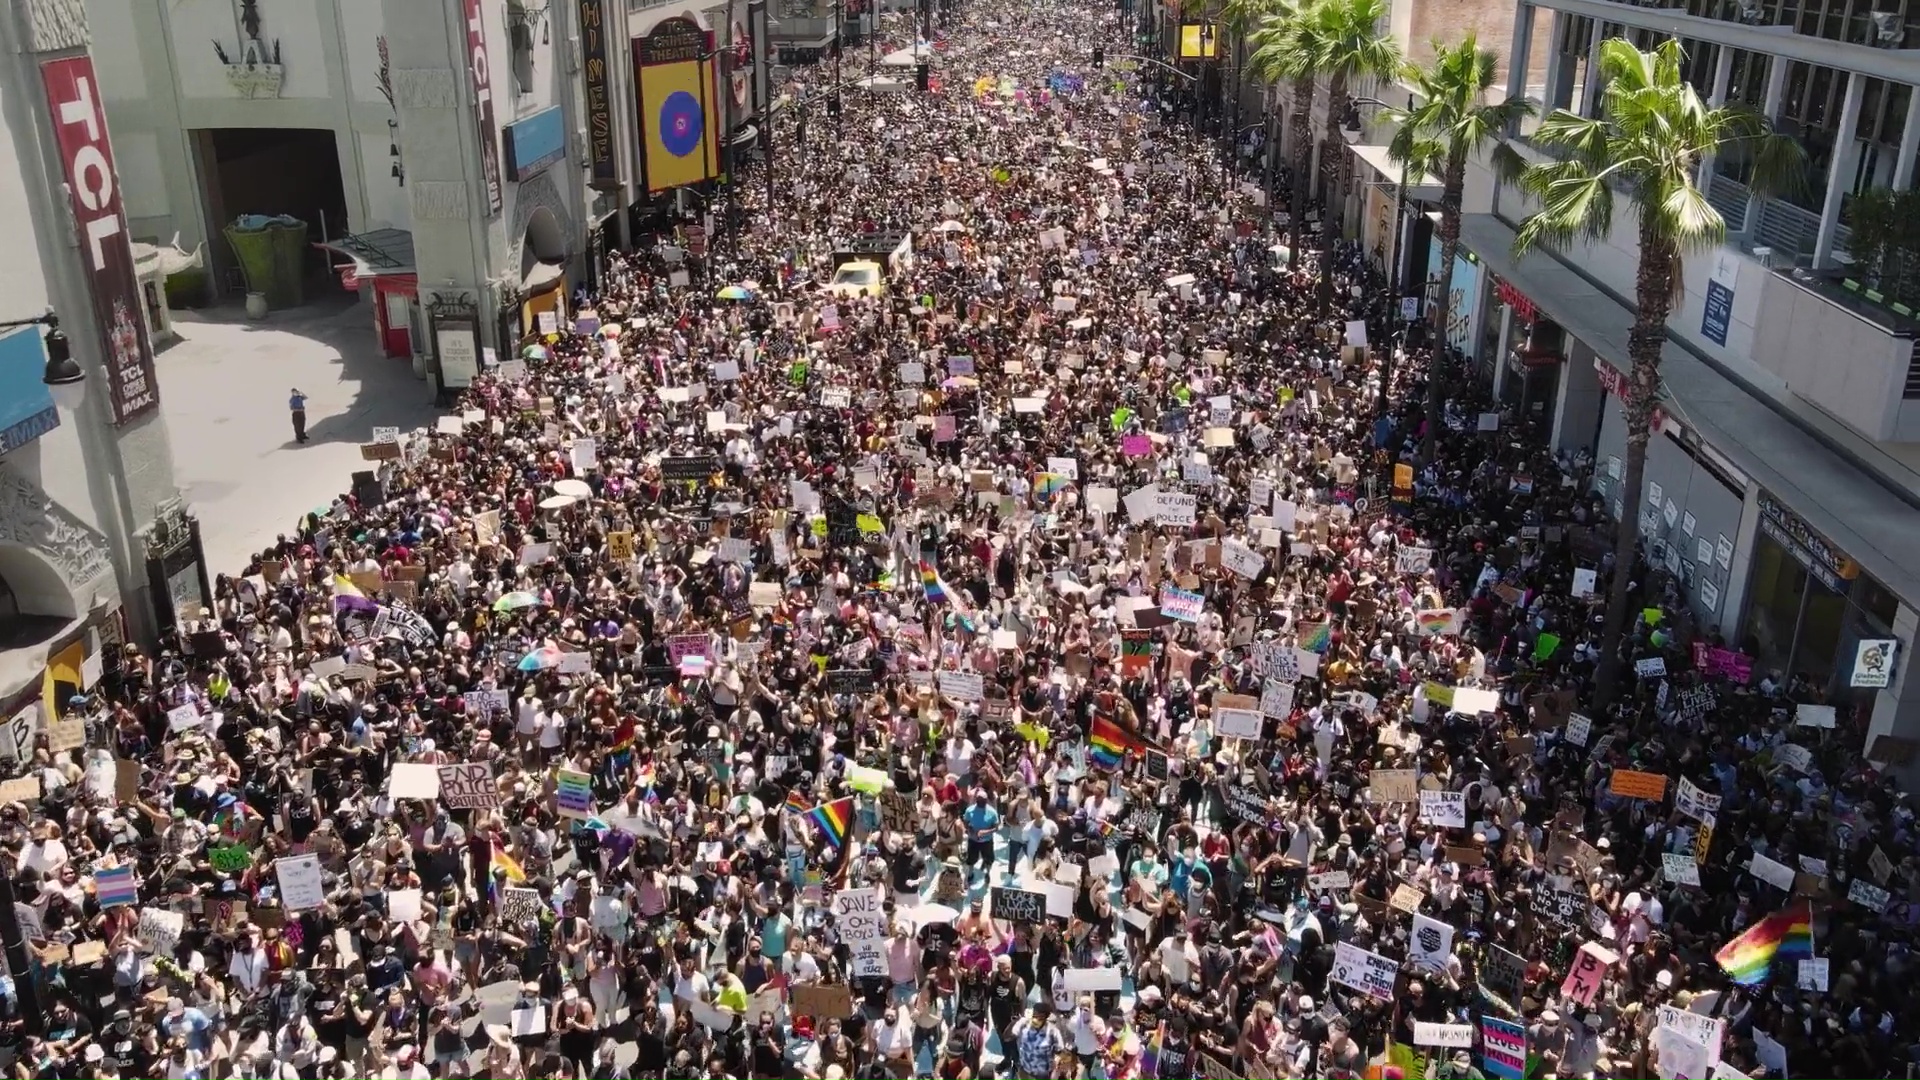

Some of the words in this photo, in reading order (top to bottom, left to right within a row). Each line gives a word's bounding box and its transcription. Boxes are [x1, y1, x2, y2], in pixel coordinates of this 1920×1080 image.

[469, 5, 490, 121] TCL
[59, 76, 120, 271] TCL
[120, 365, 144, 382] TCL
[122, 392, 154, 416] IMAX
[8, 411, 56, 451] IMAX
[1157, 497, 1195, 507] DEFUND
[1157, 513, 1192, 523] POLICE
[1173, 592, 1199, 602] BLACK
[390, 609, 430, 638] LIVES
[1251, 643, 1276, 658] BLACK
[1260, 663, 1293, 679] MATTER
[1681, 683, 1711, 699] BLACK
[1682, 690, 1714, 709] LIVES
[1682, 700, 1717, 720] MATTER
[437, 766, 488, 782] END
[441, 778, 496, 796] POLICE
[447, 795, 499, 809] BRUTALITY
[1237, 805, 1265, 827] Peace
[1001, 888, 1036, 904] BLACK
[1536, 883, 1551, 897] No
[1550, 889, 1586, 911] Justice
[1537, 896, 1552, 908] No
[840, 895, 877, 915] SAVE
[996, 898, 1036, 913] LIVES
[849, 917, 875, 929] OUR
[141, 926, 176, 942] MATTER
[844, 927, 875, 941] BOYS
[1366, 956, 1398, 973] ENOUGH
[1363, 973, 1393, 990] ENOUGH
[1572, 954, 1597, 1000] BLM
[1055, 991, 1068, 1003] 24
[1486, 1024, 1523, 1038] BLACK
[1487, 1036, 1521, 1052] LIVES
[1487, 1050, 1524, 1069] MATTER
